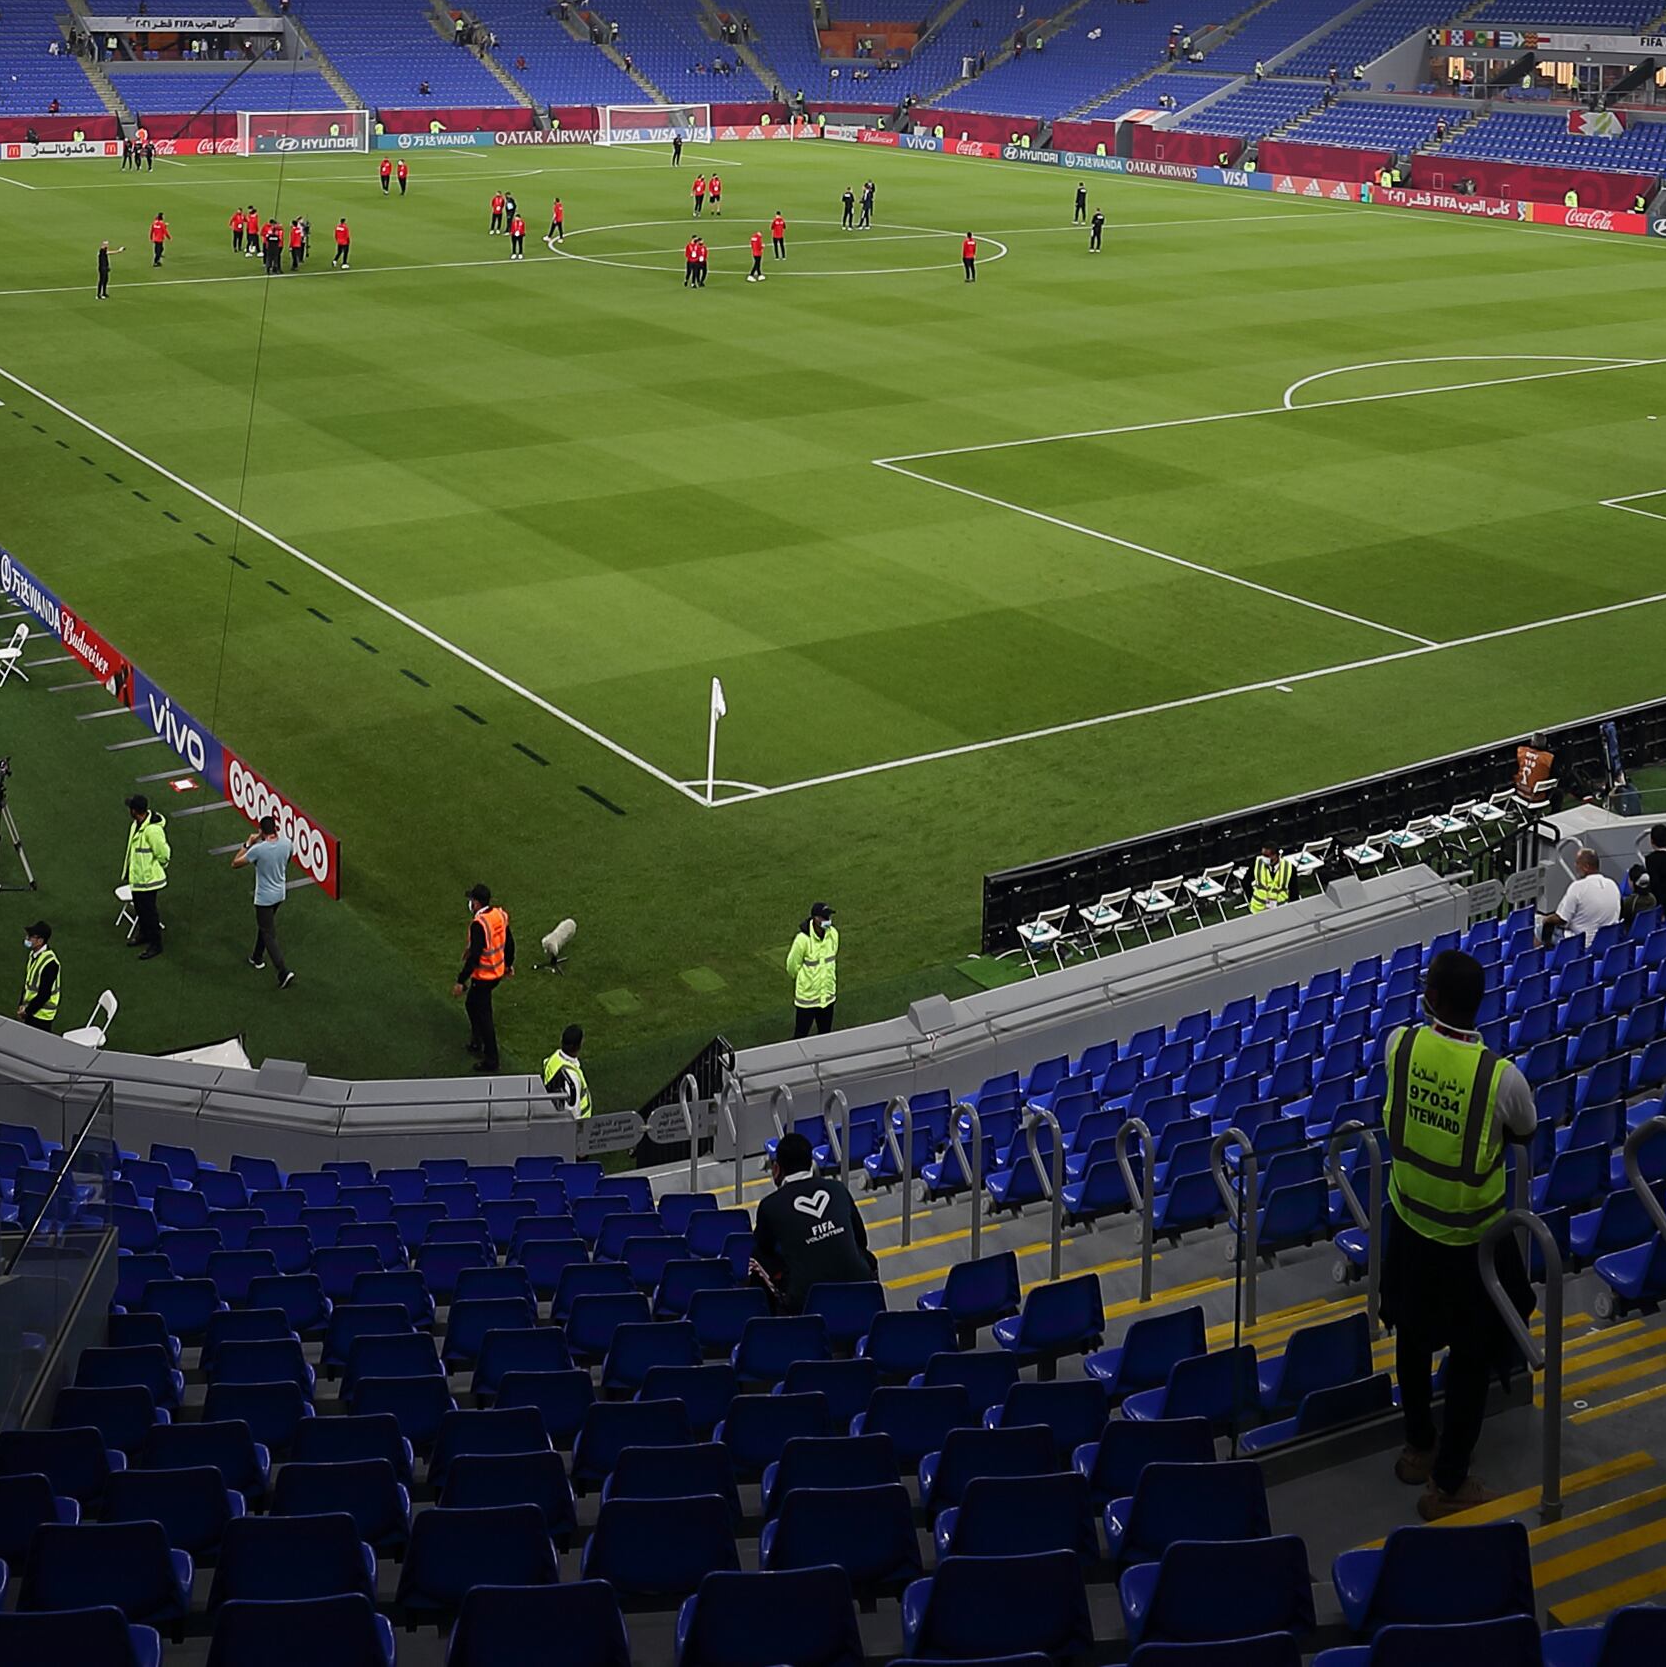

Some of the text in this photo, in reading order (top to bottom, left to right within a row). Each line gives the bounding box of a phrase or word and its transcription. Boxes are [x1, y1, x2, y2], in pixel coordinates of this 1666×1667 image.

[175, 19, 194, 28] FIFA
[1640, 36, 1663, 47] FIFA
[495, 128, 606, 146] QATAR AIRWAYS
[612, 130, 641, 142] VISA
[649, 129, 677, 141] VISA
[684, 128, 712, 141] VISA
[302, 137, 358, 148] HYUNDAI
[907, 138, 937, 151] vivo
[1020, 150, 1059, 164] HYUNDAI
[1126, 161, 1198, 179] QATAR AIRWAYS
[1221, 170, 1249, 187] VISA
[1406, 194, 1431, 207] قطر
[1433, 196, 1457, 209] FIFA
[1458, 199, 1486, 214] العرب
[1487, 202, 1510, 216] كأس
[62, 610, 109, 675] Budweiser
[148, 692, 205, 772] vivo
[1409, 1084, 1460, 1115] 97034
[811, 1220, 835, 1236] FIFA
